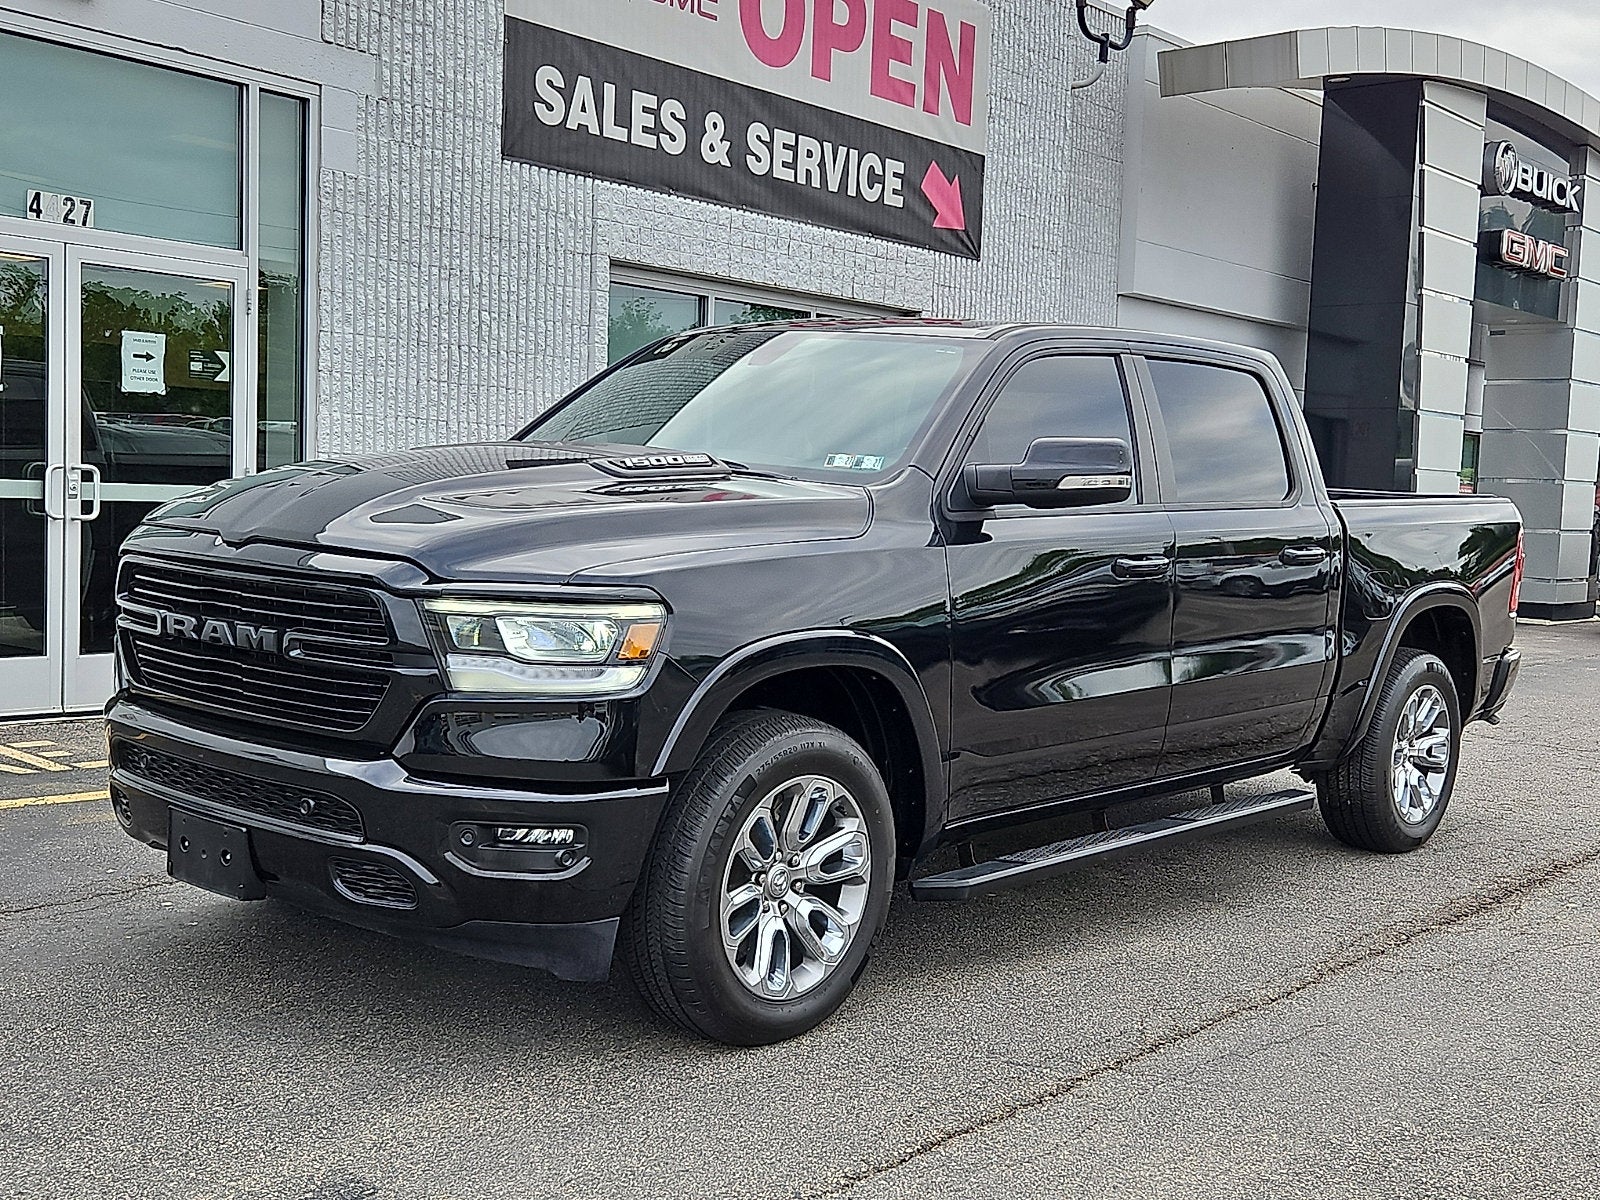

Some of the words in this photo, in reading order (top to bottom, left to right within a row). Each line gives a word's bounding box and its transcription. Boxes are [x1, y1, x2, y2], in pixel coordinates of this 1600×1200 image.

[737, 0, 976, 127] OPEN
[534, 65, 687, 156] SALES
[700, 111, 732, 168] &
[746, 122, 905, 208] SERVICE
[1517, 160, 1581, 212] BUICK
[1501, 229, 1569, 279] GMC
[620, 455, 685, 467] 1500
[165, 611, 278, 653] RAM
[755, 745, 799, 776] 275/55R20
